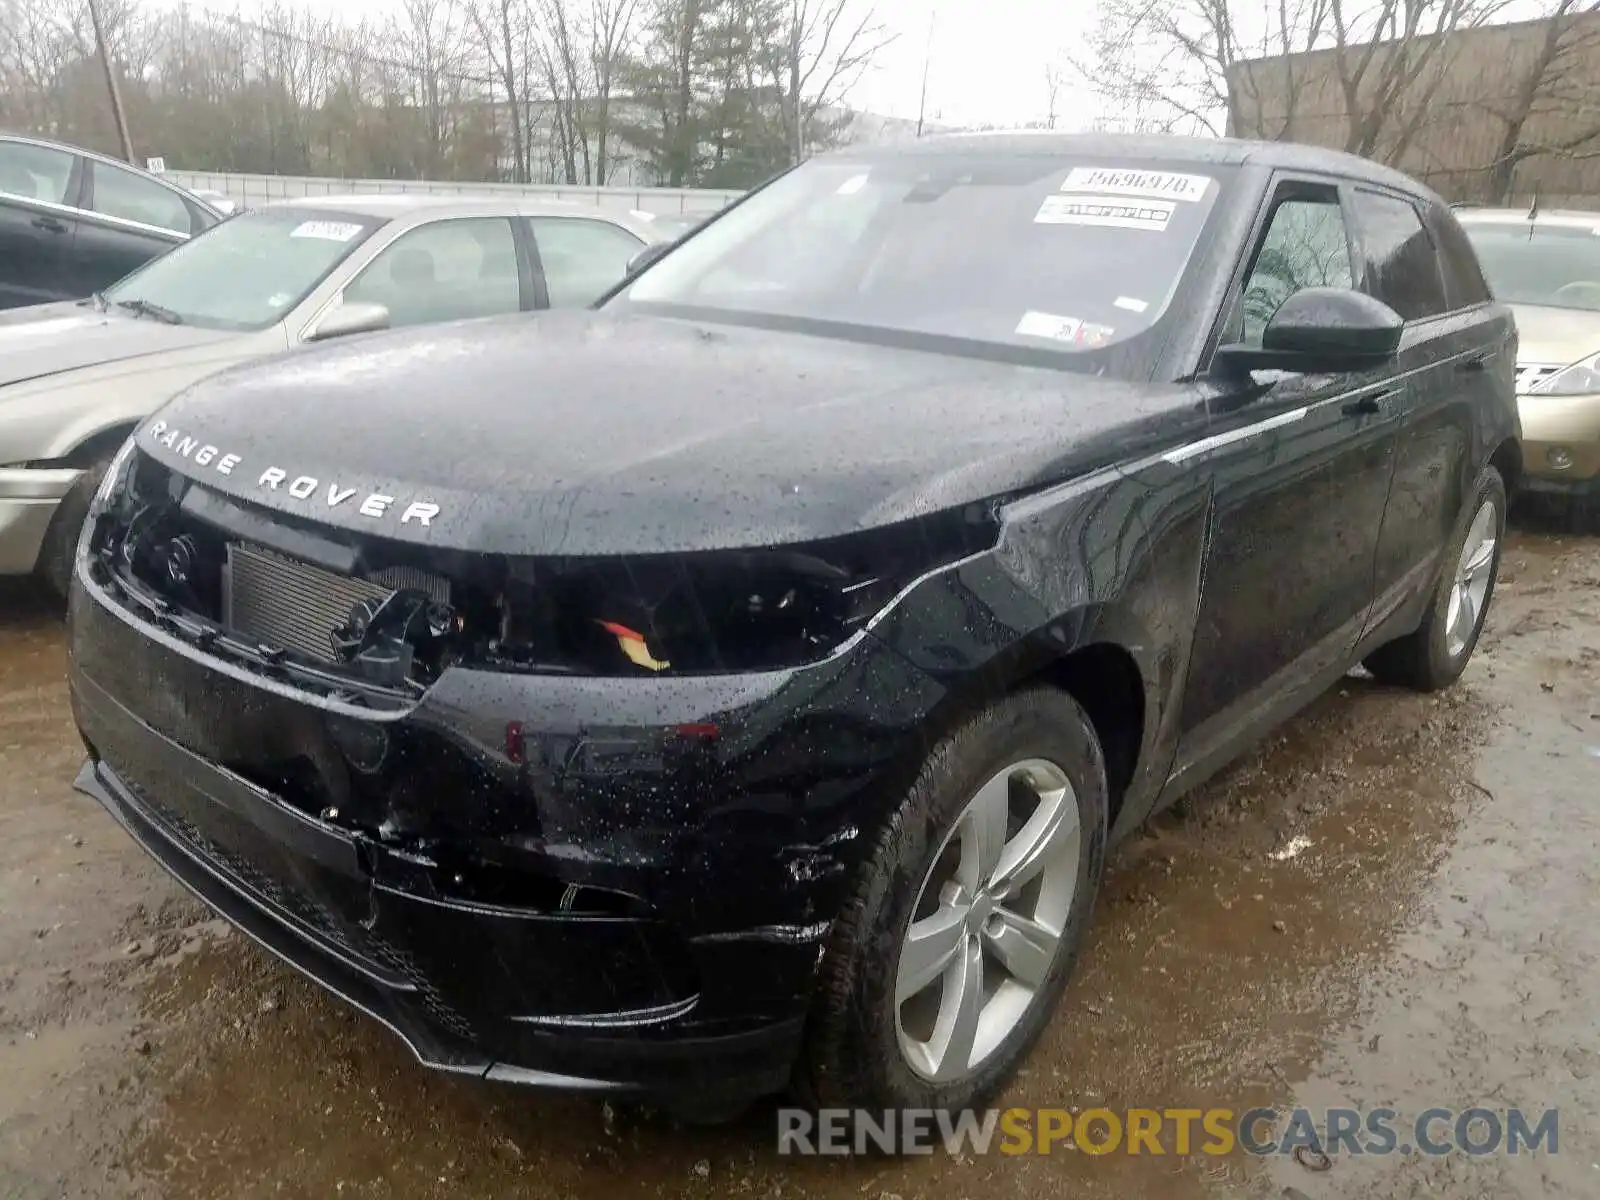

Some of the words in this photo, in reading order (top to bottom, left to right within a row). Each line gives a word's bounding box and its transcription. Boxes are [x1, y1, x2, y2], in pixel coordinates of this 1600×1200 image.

[1046, 203, 1169, 222] nterprise
[150, 420, 243, 476] RANGE
[258, 466, 441, 527] ROVER
